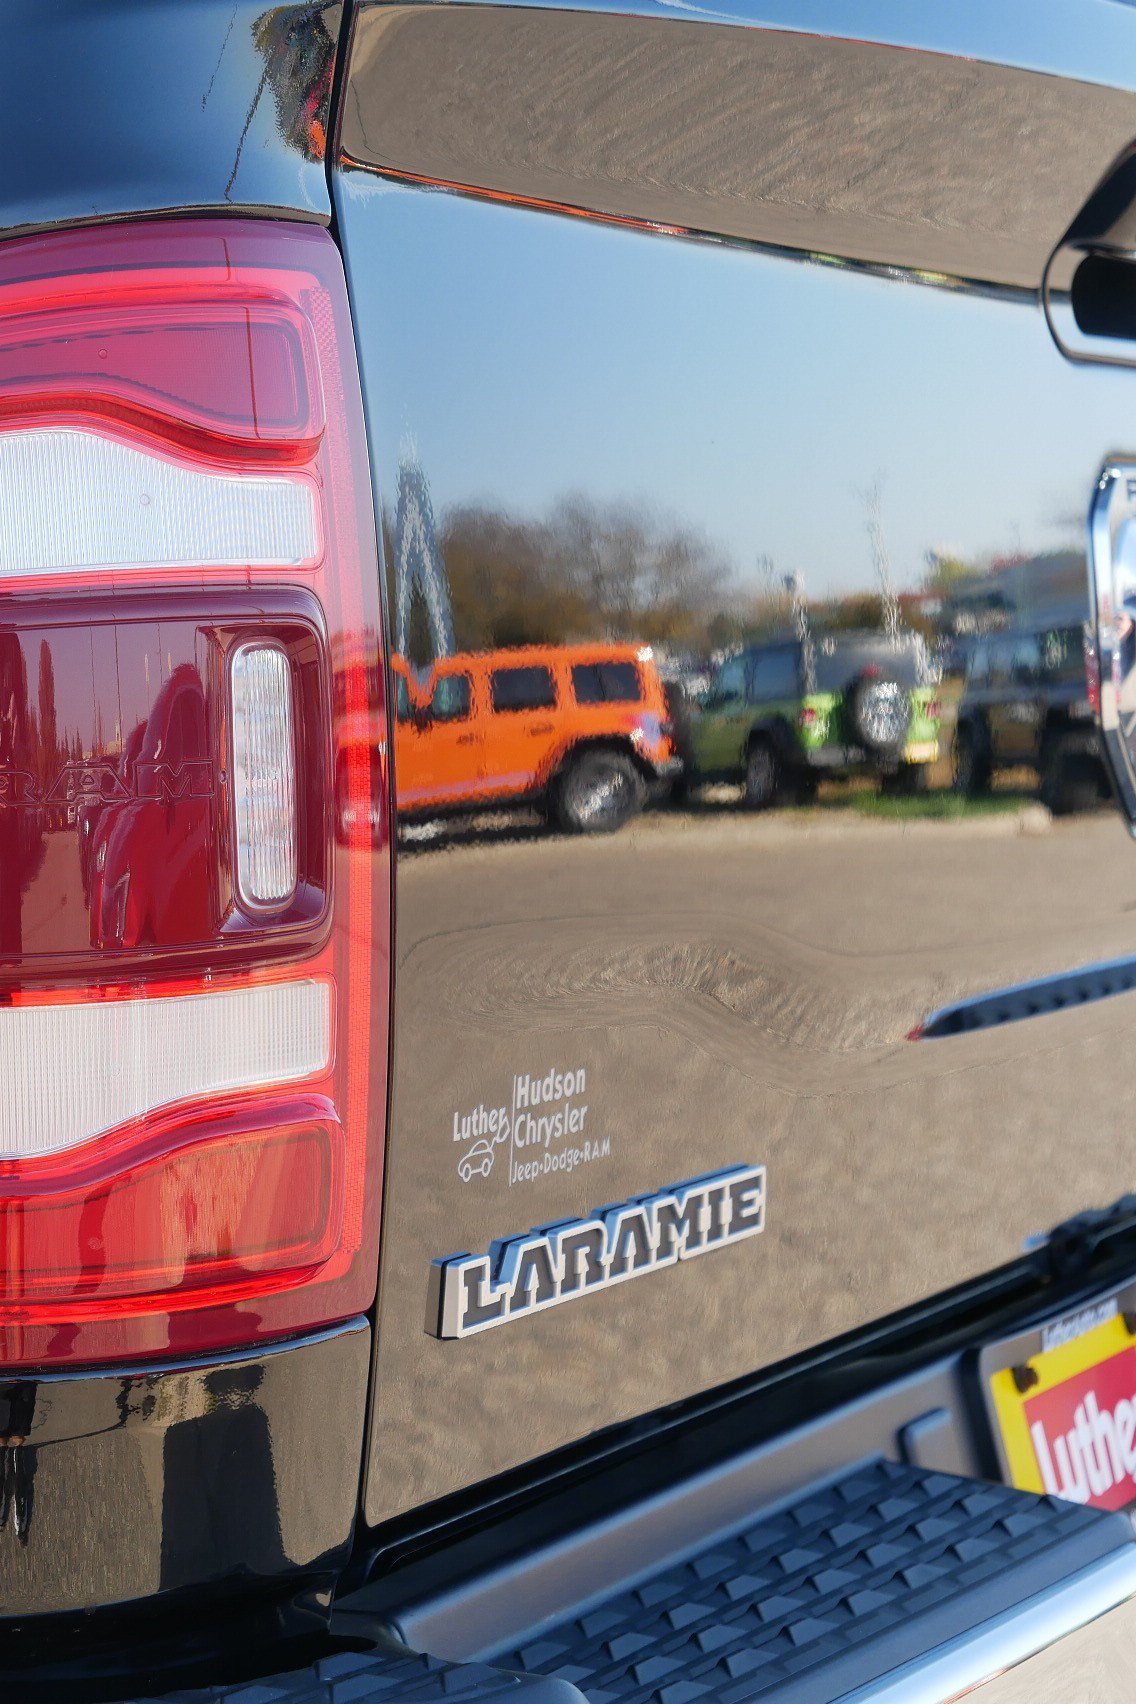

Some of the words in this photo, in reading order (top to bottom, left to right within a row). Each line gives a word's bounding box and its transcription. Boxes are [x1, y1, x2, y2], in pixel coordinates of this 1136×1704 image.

[516, 1067, 586, 1110] Hudson
[452, 1104, 507, 1142] Luther
[514, 1101, 589, 1149] Chrysler
[456, 1164, 767, 1339] LARAMIE
[1030, 1389, 1136, 1506] Luthe
